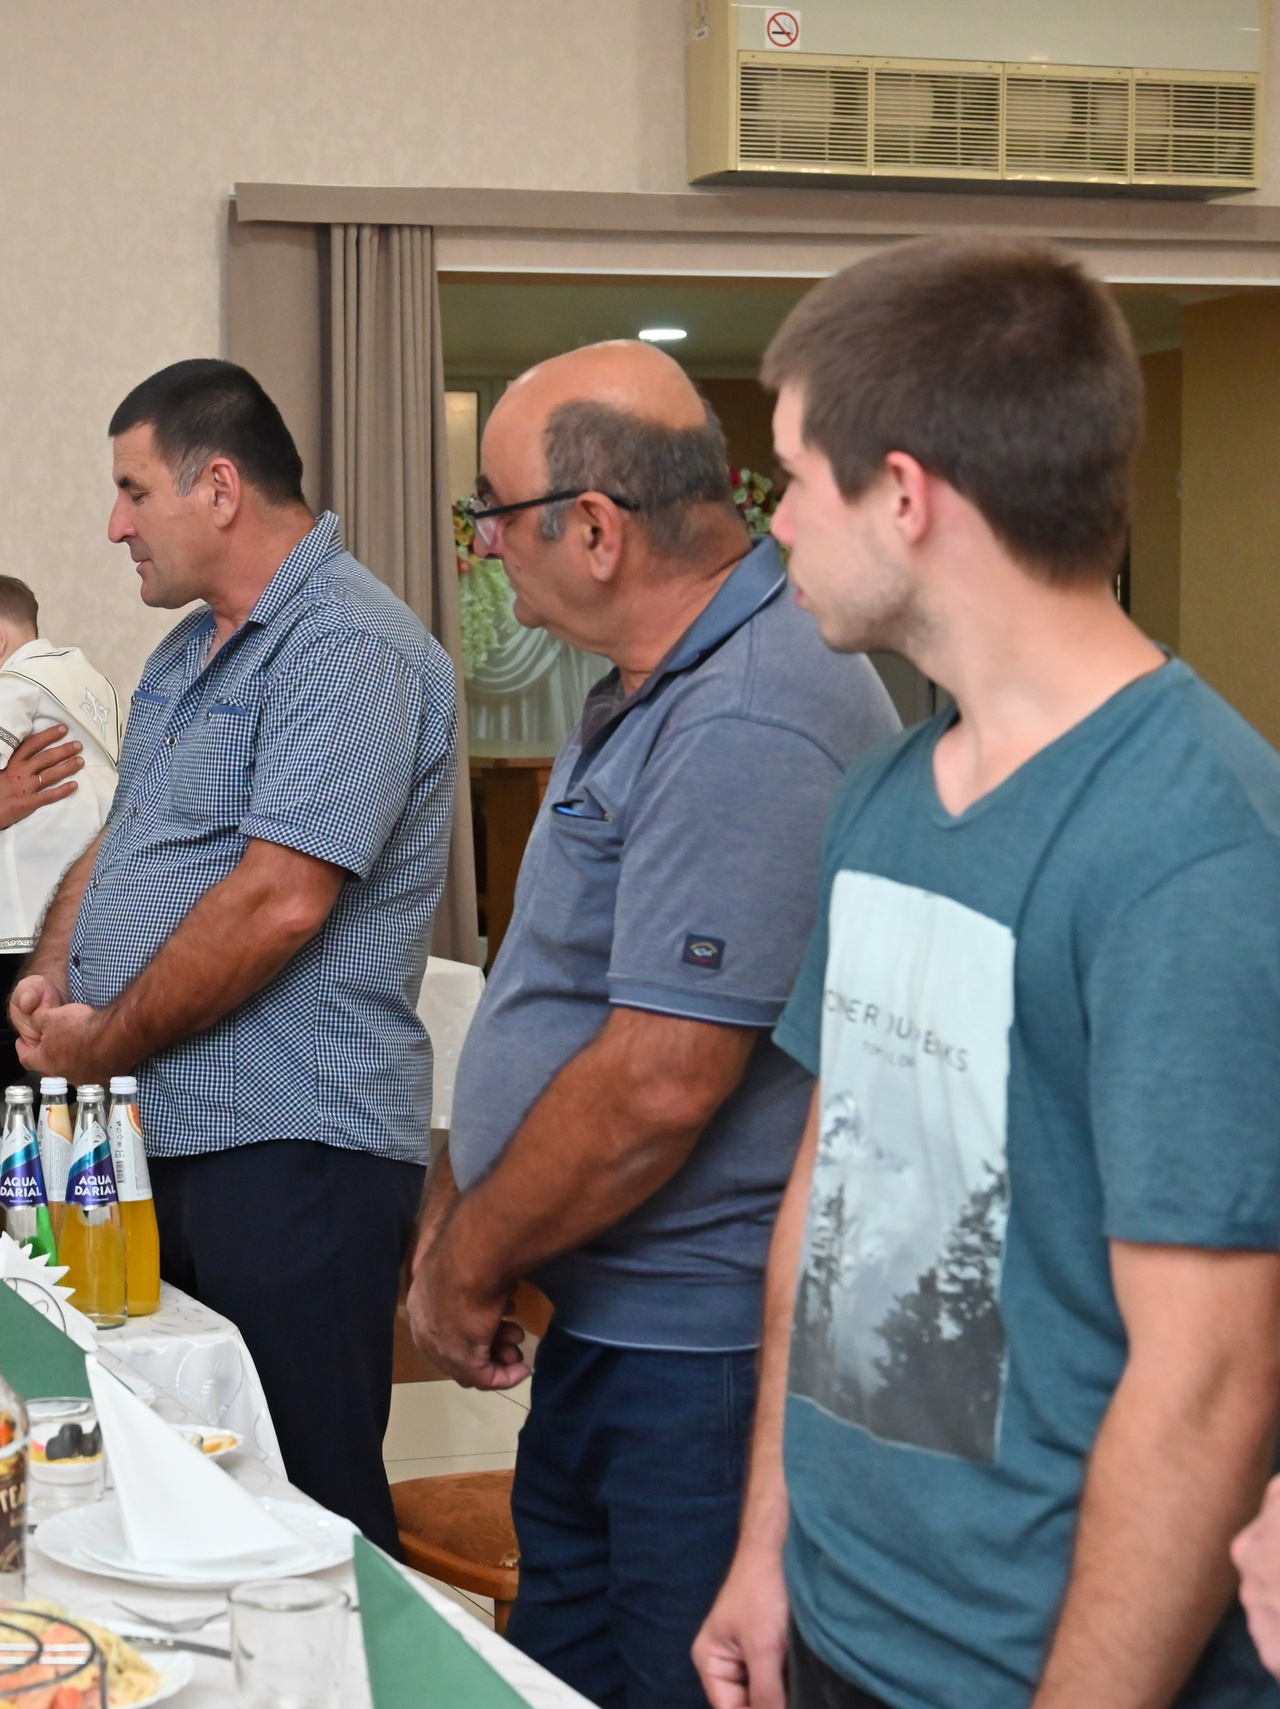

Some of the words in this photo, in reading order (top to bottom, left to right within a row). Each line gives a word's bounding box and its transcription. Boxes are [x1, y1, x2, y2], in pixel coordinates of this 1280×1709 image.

[3, 1176, 37, 1187] AQUA
[78, 1175, 112, 1186] AQUA
[0, 1186, 42, 1198] DARIAL
[74, 1184, 117, 1196] DARIAL
